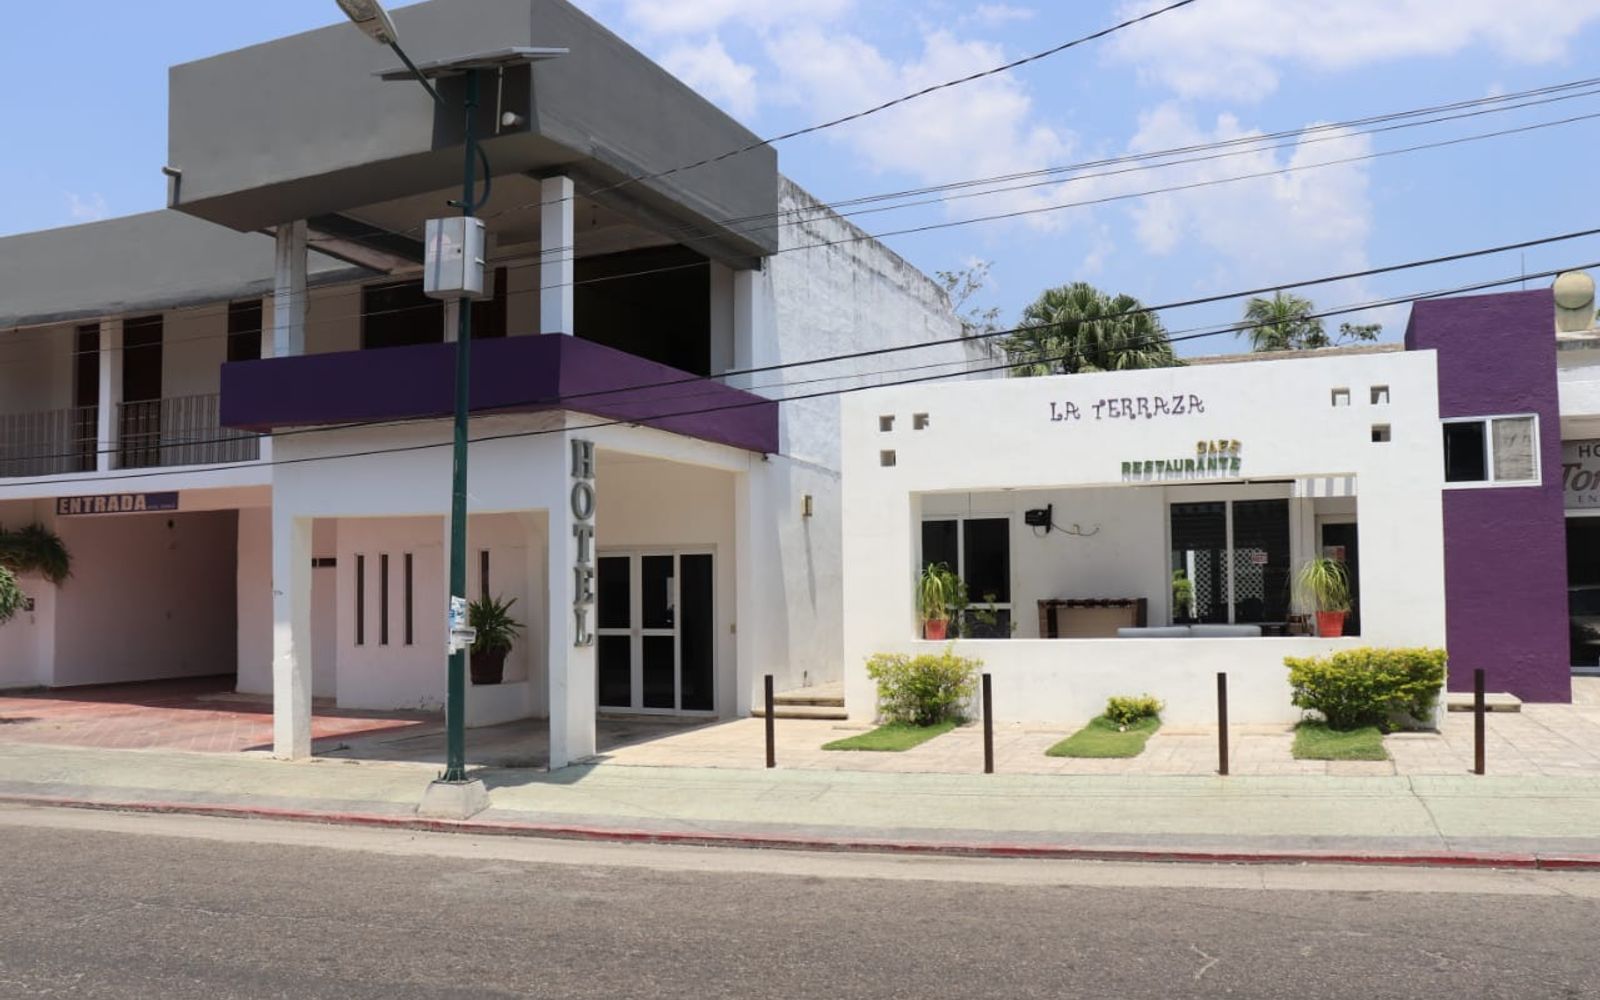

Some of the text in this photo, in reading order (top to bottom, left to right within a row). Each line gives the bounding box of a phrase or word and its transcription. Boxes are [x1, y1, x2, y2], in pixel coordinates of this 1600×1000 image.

[1051, 394, 1205, 421] LA TERRAZA
[1121, 457, 1242, 475] RESTAURANTE
[59, 495, 146, 513] ENTRADA
[570, 439, 595, 646] HOTEL
